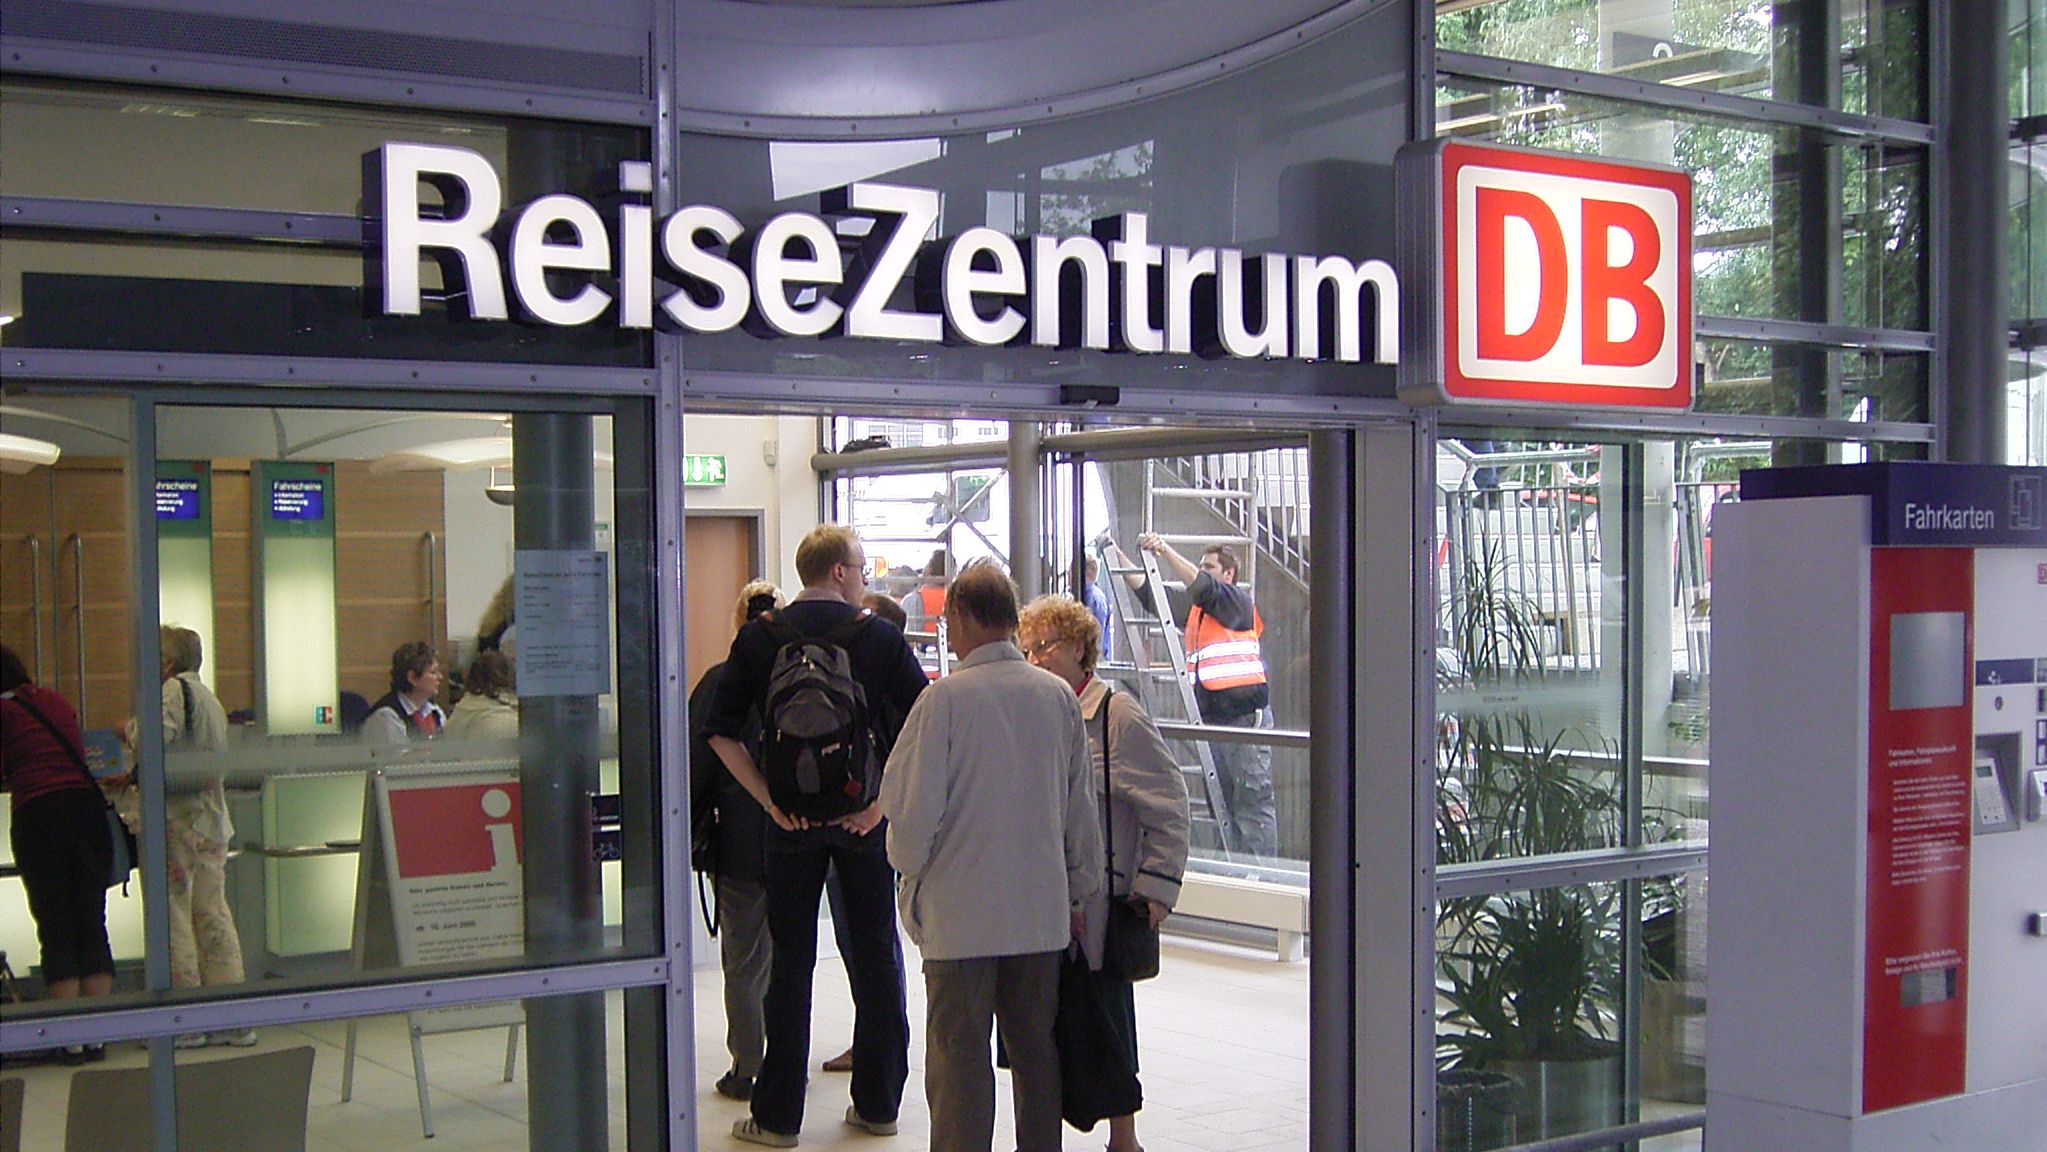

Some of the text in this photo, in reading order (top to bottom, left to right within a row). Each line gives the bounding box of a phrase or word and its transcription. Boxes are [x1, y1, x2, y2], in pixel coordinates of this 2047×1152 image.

[382, 140, 1400, 364] ReiseZentrum
[1476, 186, 1667, 367] DB
[274, 481, 322, 491] Fahrscheine
[1905, 503, 1995, 530] Fahrkarten
